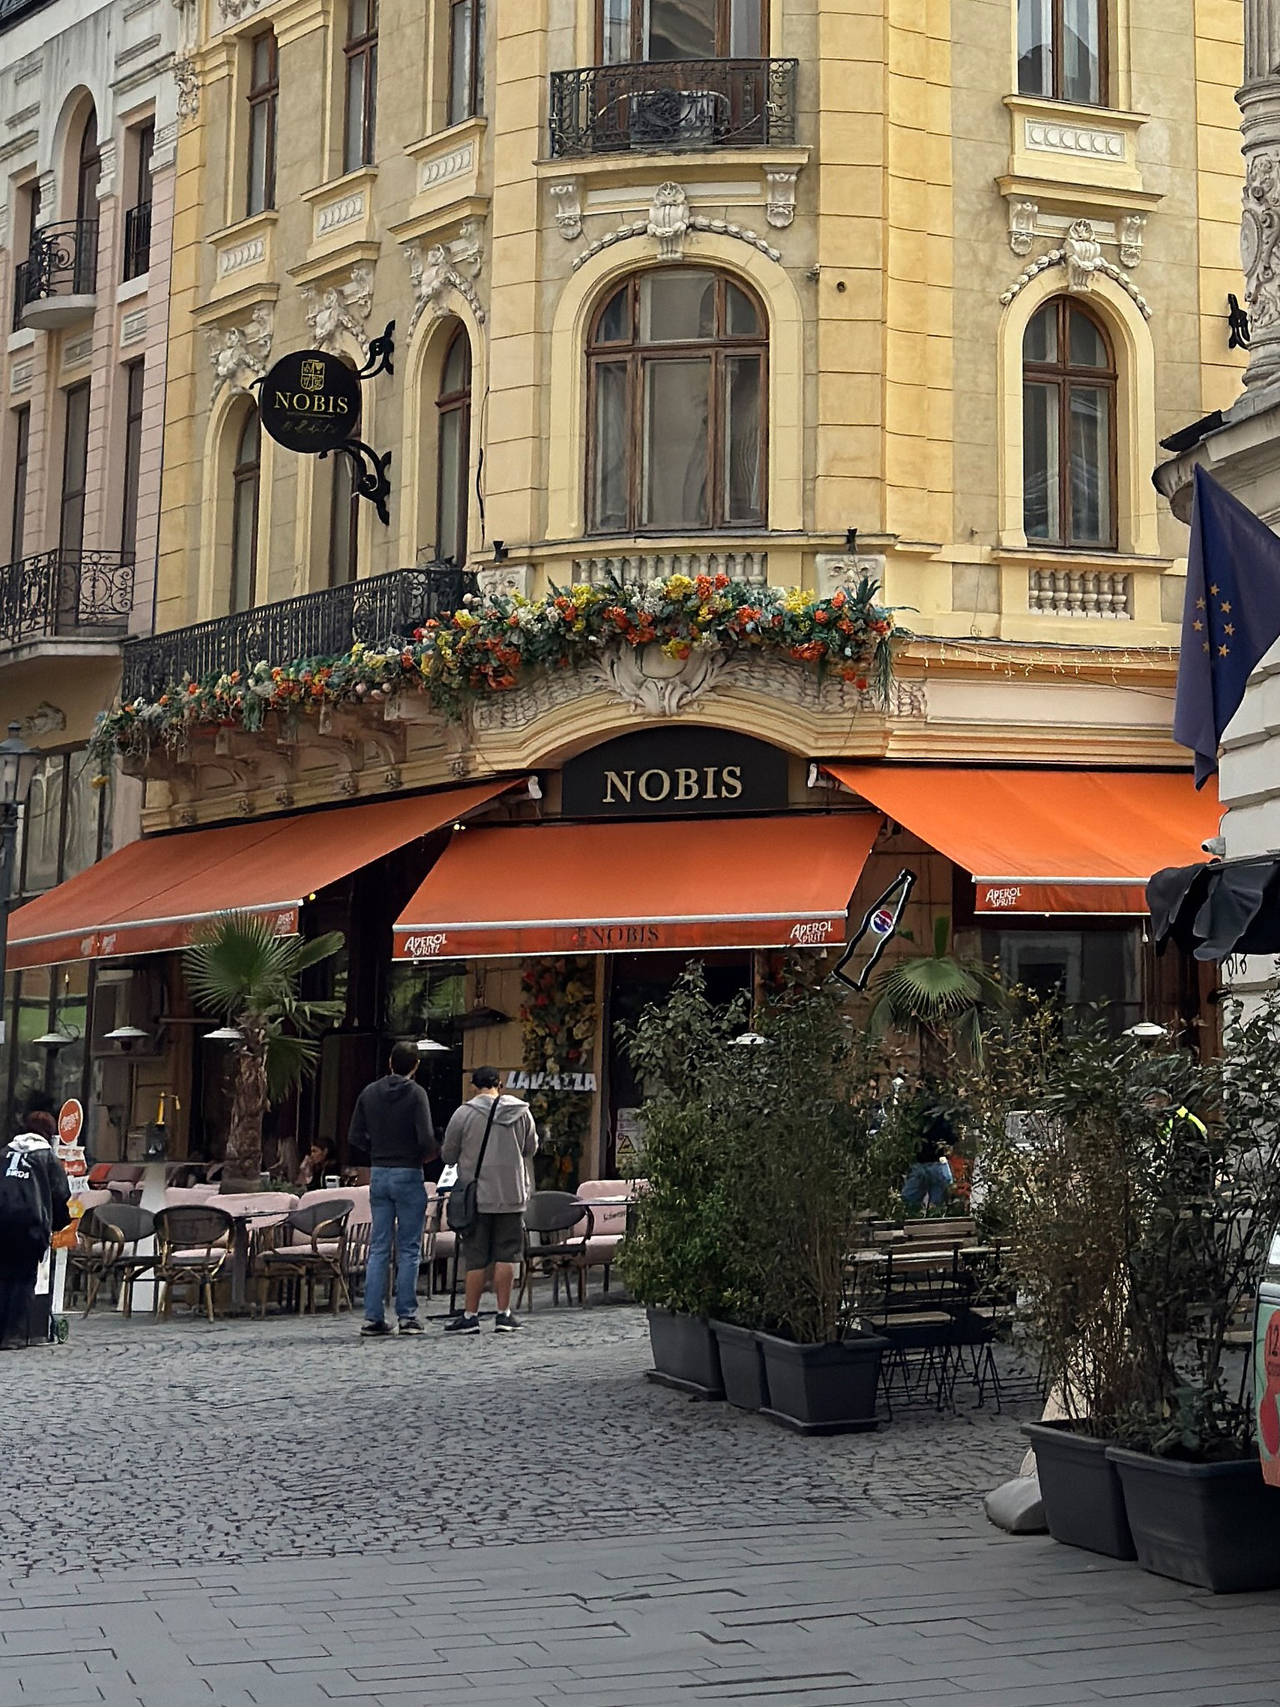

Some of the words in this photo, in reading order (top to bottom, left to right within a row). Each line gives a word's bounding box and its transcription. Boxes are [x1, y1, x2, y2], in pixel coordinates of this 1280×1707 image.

[273, 391, 348, 414] NOBIS
[602, 765, 743, 803] NOBIS
[986, 887, 1022, 902] APEROL
[592, 926, 659, 943] NOBIS
[790, 921, 833, 938] APEROL
[404, 933, 447, 951] APEROL
